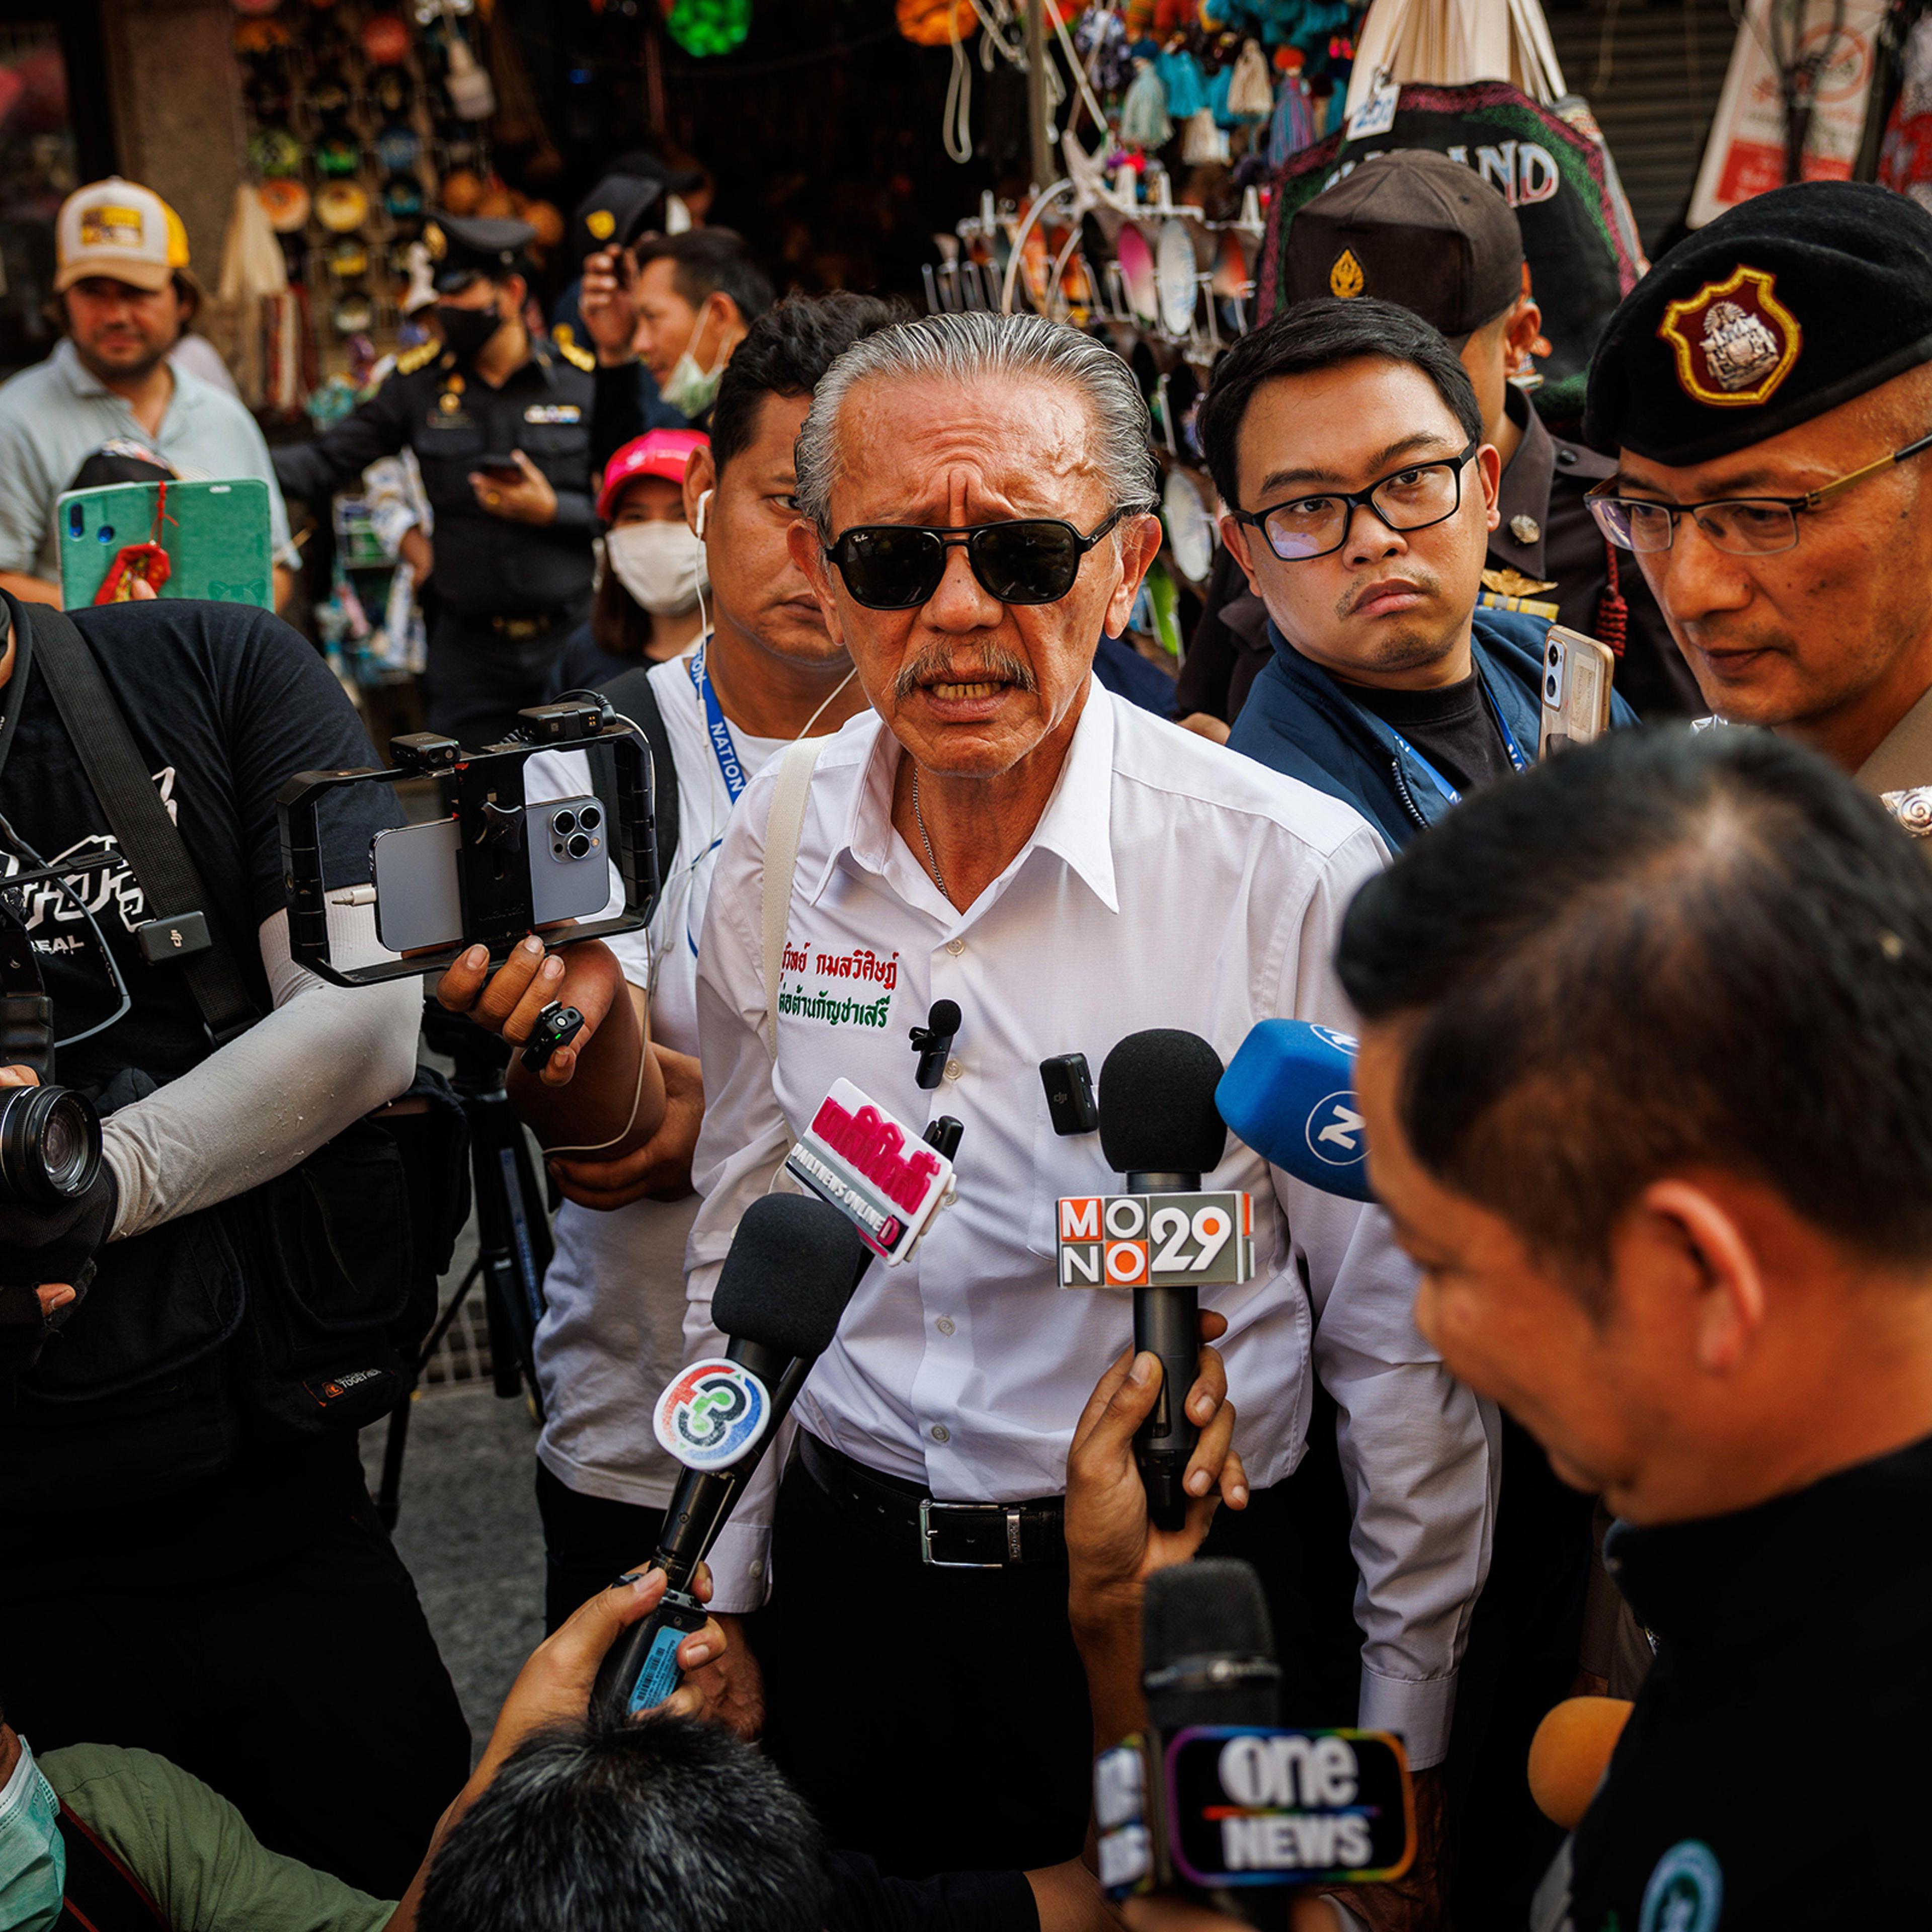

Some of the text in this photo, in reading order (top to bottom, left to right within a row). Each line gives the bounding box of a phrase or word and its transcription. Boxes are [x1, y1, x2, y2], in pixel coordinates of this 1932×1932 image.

[710, 721, 745, 793] NATION
[843, 1189, 886, 1231] ONLINE
[1218, 1734, 1358, 1808] one
[1222, 1814, 1373, 1870] NEWS
